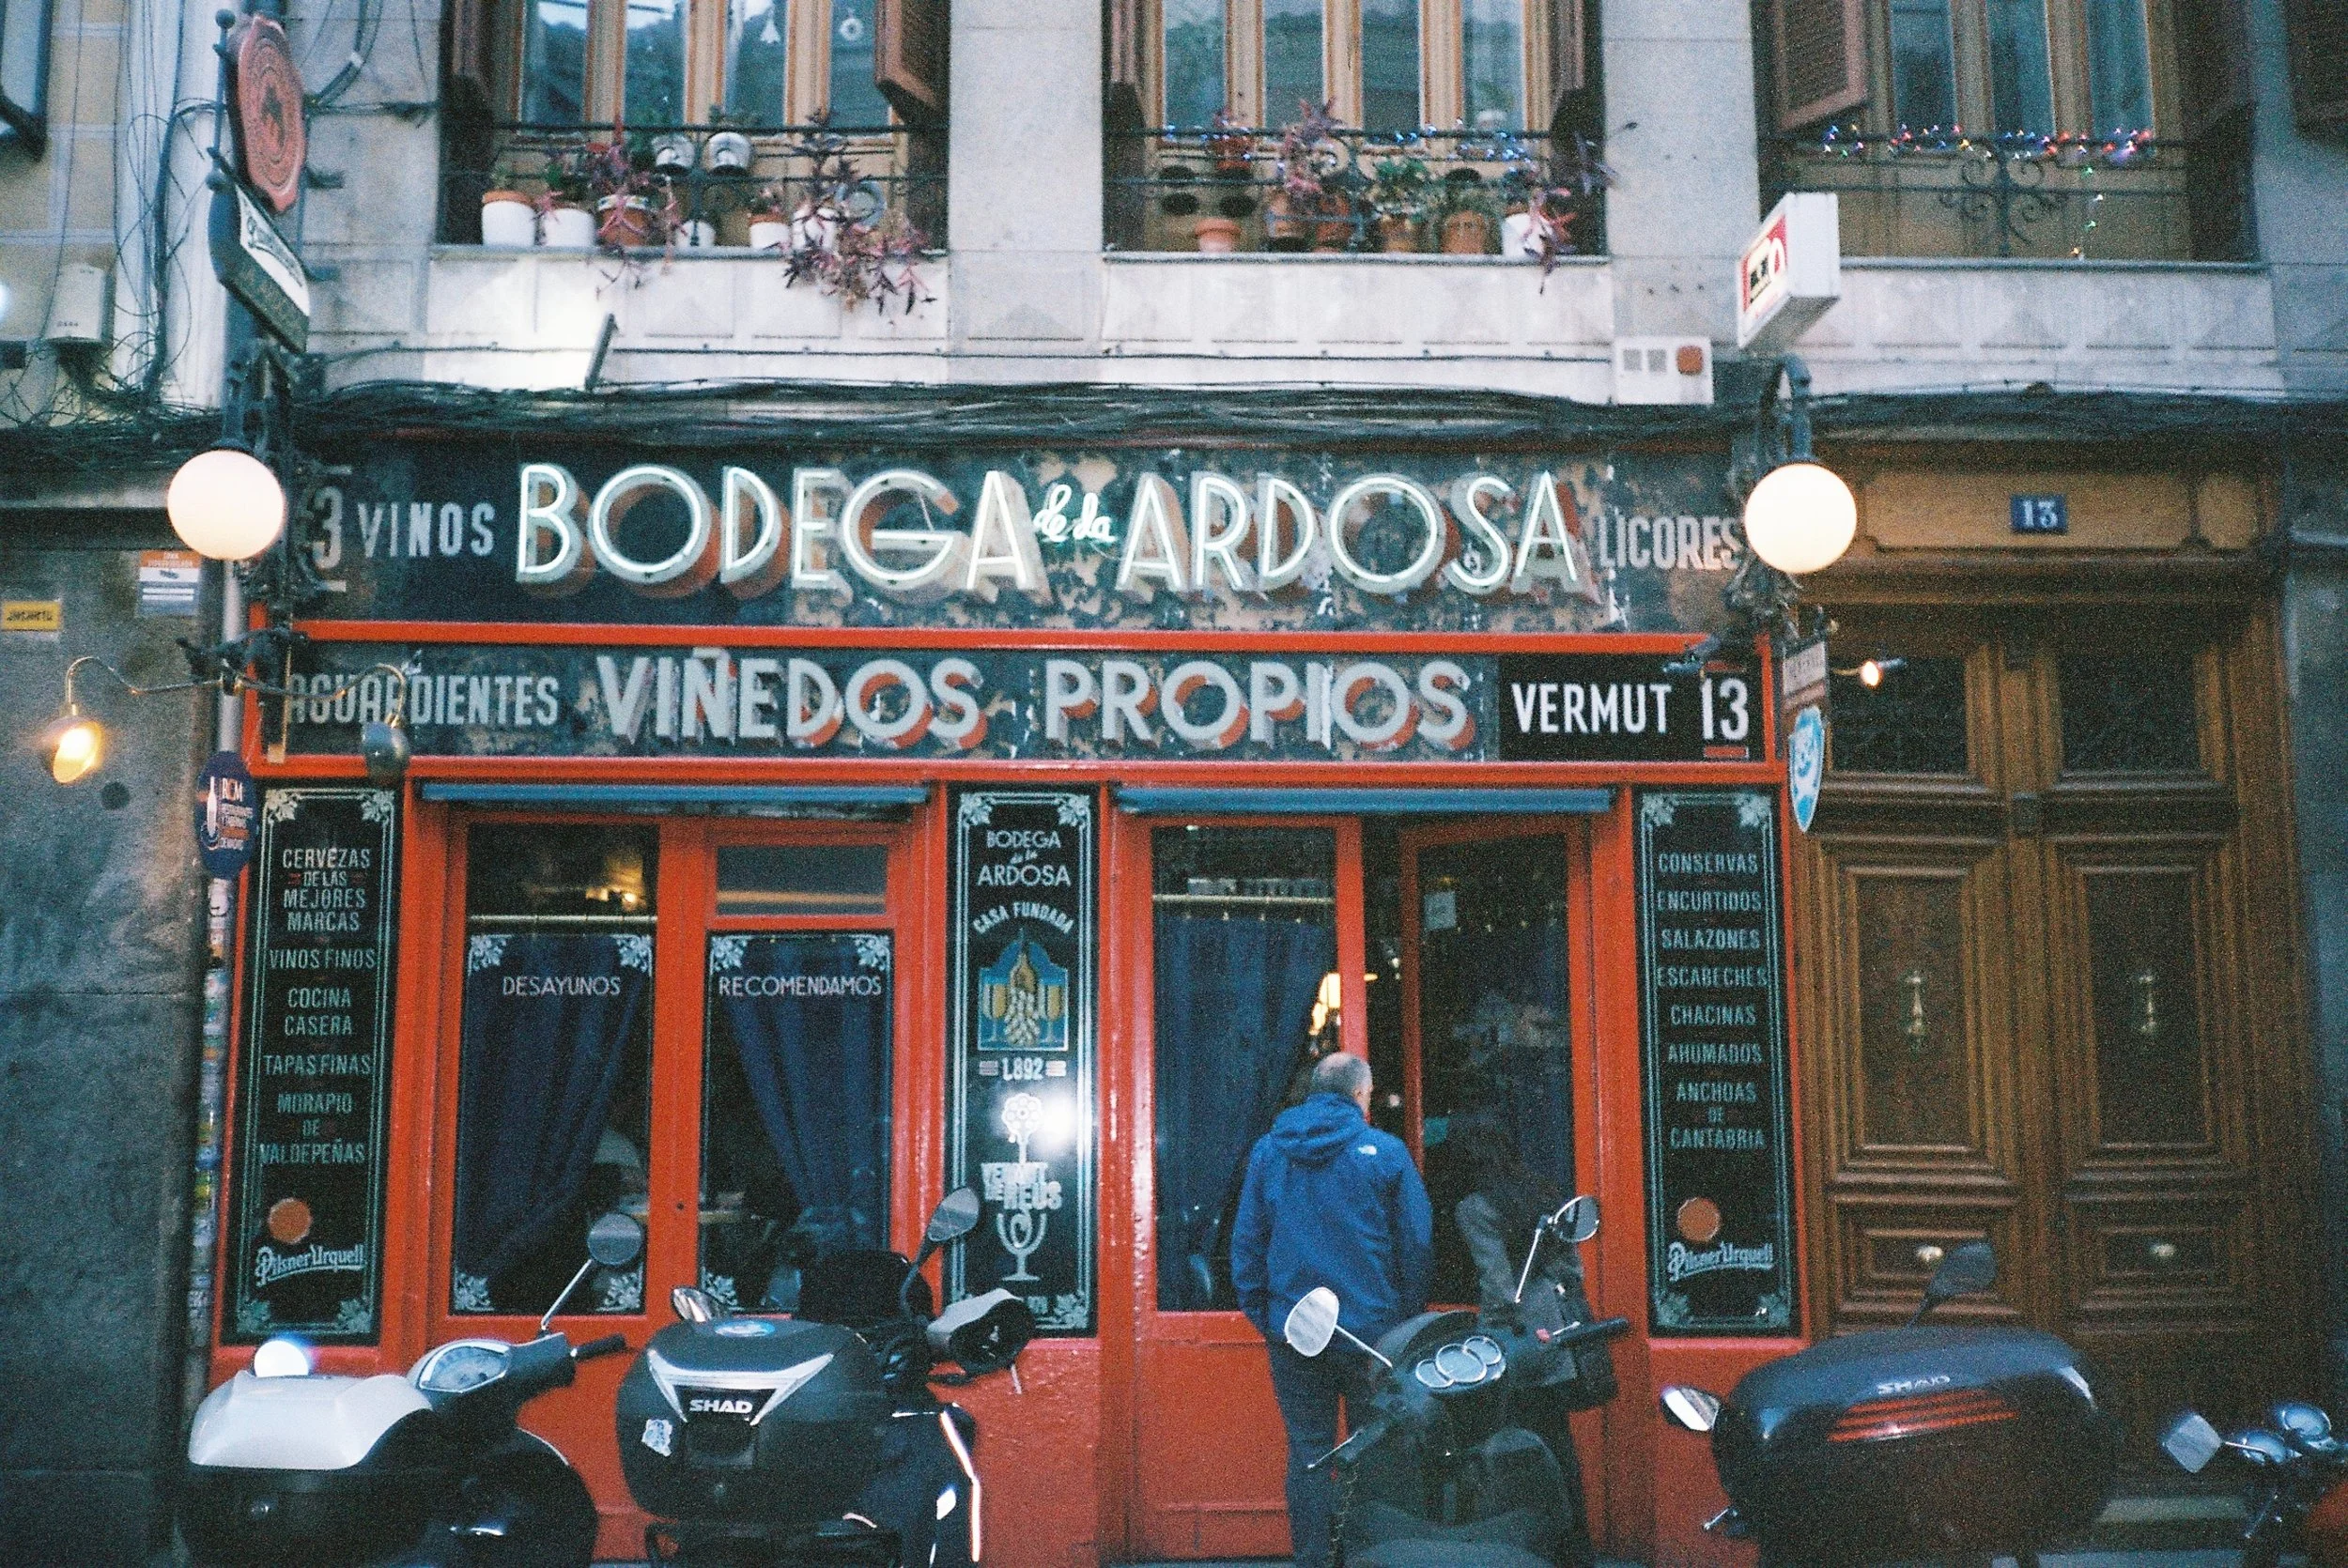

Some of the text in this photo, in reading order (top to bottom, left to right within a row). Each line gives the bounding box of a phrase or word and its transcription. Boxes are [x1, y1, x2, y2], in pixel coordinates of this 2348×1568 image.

[2022, 499, 2059, 528] 13
[358, 501, 496, 557] VINOS
[516, 463, 1587, 594] BODEGA de la ARDOSA
[1599, 515, 1741, 570] LICORES
[596, 648, 1475, 749] VIÑEDOS PROPIOS
[1511, 678, 1749, 740] VERMUT 13
[986, 831, 1061, 849] BODEGA
[283, 847, 371, 869] CERVEZAS
[1658, 852, 1758, 874] CONSERVAS
[303, 870, 348, 887] DE LAS
[978, 865, 1072, 887] ARDOSA
[284, 887, 367, 909] MEJORES
[1657, 891, 1762, 912] ENCURTIDOS
[287, 911, 361, 932] MARCAS
[973, 901, 1074, 934] CASA FUNDADA
[1661, 928, 1760, 949] SALAZONES
[270, 948, 376, 969] VINOS FINOS
[502, 976, 622, 996] DESAYUNOS
[718, 976, 883, 996] RECOMENDAMOS
[1658, 966, 1769, 987] ESCABECHES
[287, 987, 351, 1009] COCINA
[285, 1015, 353, 1037] CASERA
[1670, 1005, 1756, 1026] CHACINAS
[263, 1053, 372, 1076] TAPAS FINAS
[1668, 1043, 1763, 1065] AHUMADOS
[1001, 1057, 1044, 1081] 1892
[1676, 1082, 1757, 1102] ANCHOAS
[1670, 1128, 1766, 1150] CANTABRIA
[259, 1137, 365, 1164] VALDEPEÑAS
[688, 1399, 753, 1414] SHAD
